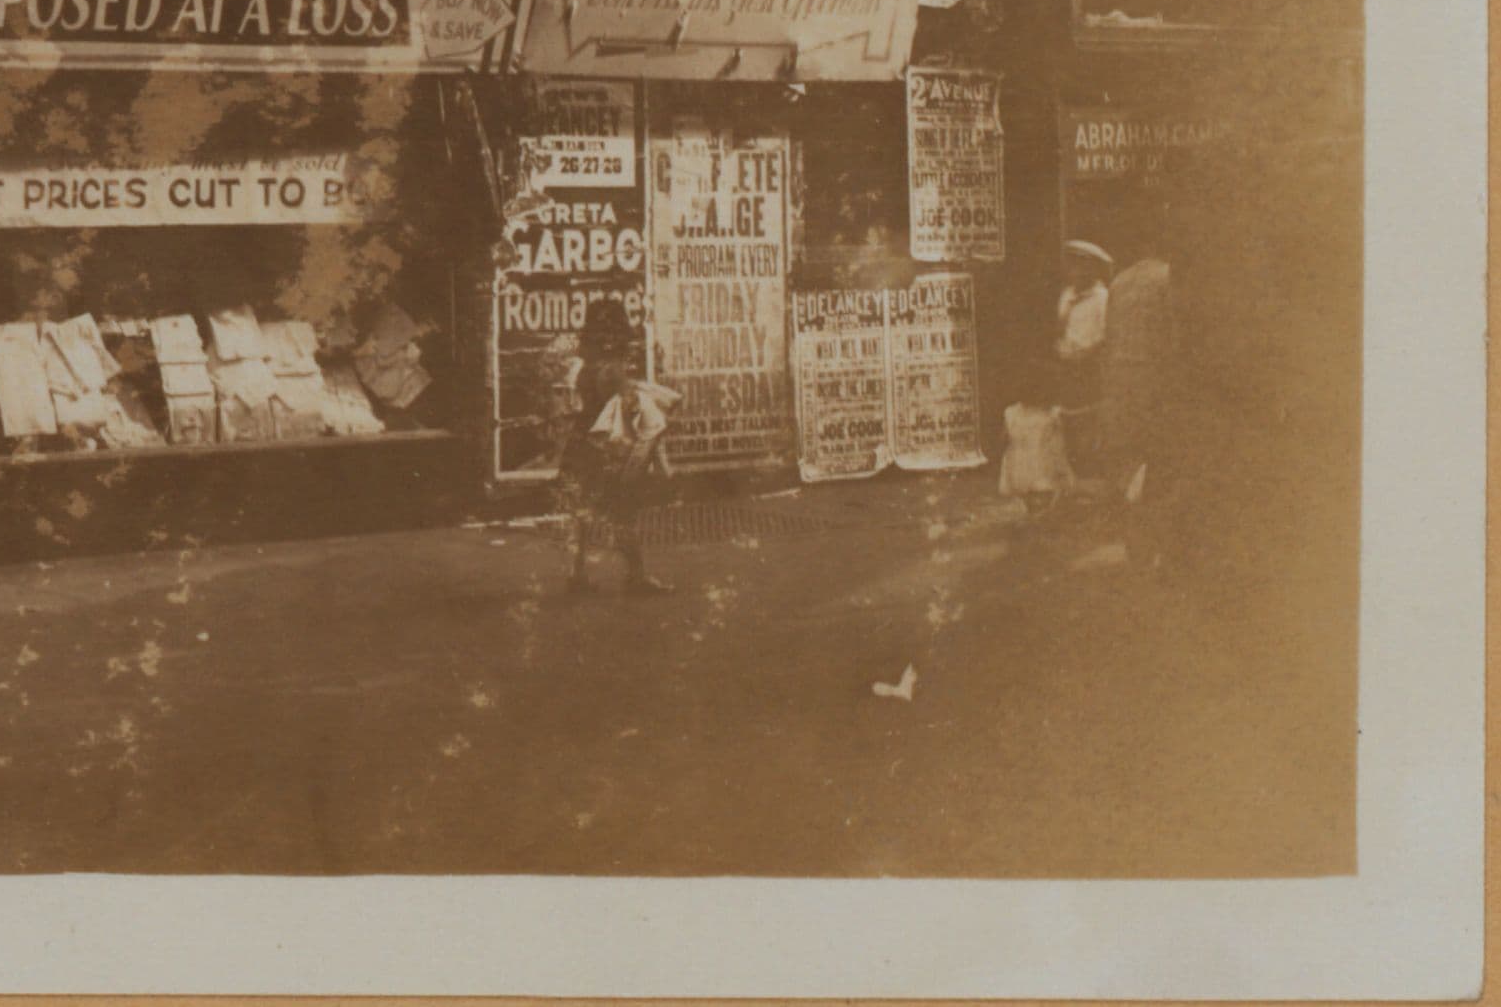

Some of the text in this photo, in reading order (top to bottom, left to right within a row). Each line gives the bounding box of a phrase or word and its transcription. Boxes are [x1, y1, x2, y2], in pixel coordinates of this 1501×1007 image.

[443, 20, 485, 41] SAVE
[929, 77, 993, 103] AVENUE
[1073, 121, 1168, 150] ABRAHAM
[656, 151, 778, 194] CPETE
[24, 177, 147, 211] PRICES
[167, 177, 240, 209] CUT
[257, 177, 306, 208] TO
[536, 202, 618, 225] GRETA
[917, 207, 998, 229] JOE COOK
[506, 227, 644, 275] GARBO
[677, 243, 737, 280] PROGRAM
[740, 243, 779, 279] EVERY
[677, 281, 760, 325] FRIDAY
[807, 290, 884, 321] DELANCEY
[898, 286, 970, 316] DELANCEY
[671, 325, 768, 371] MONDAY
[819, 418, 884, 442] JOE COOK
